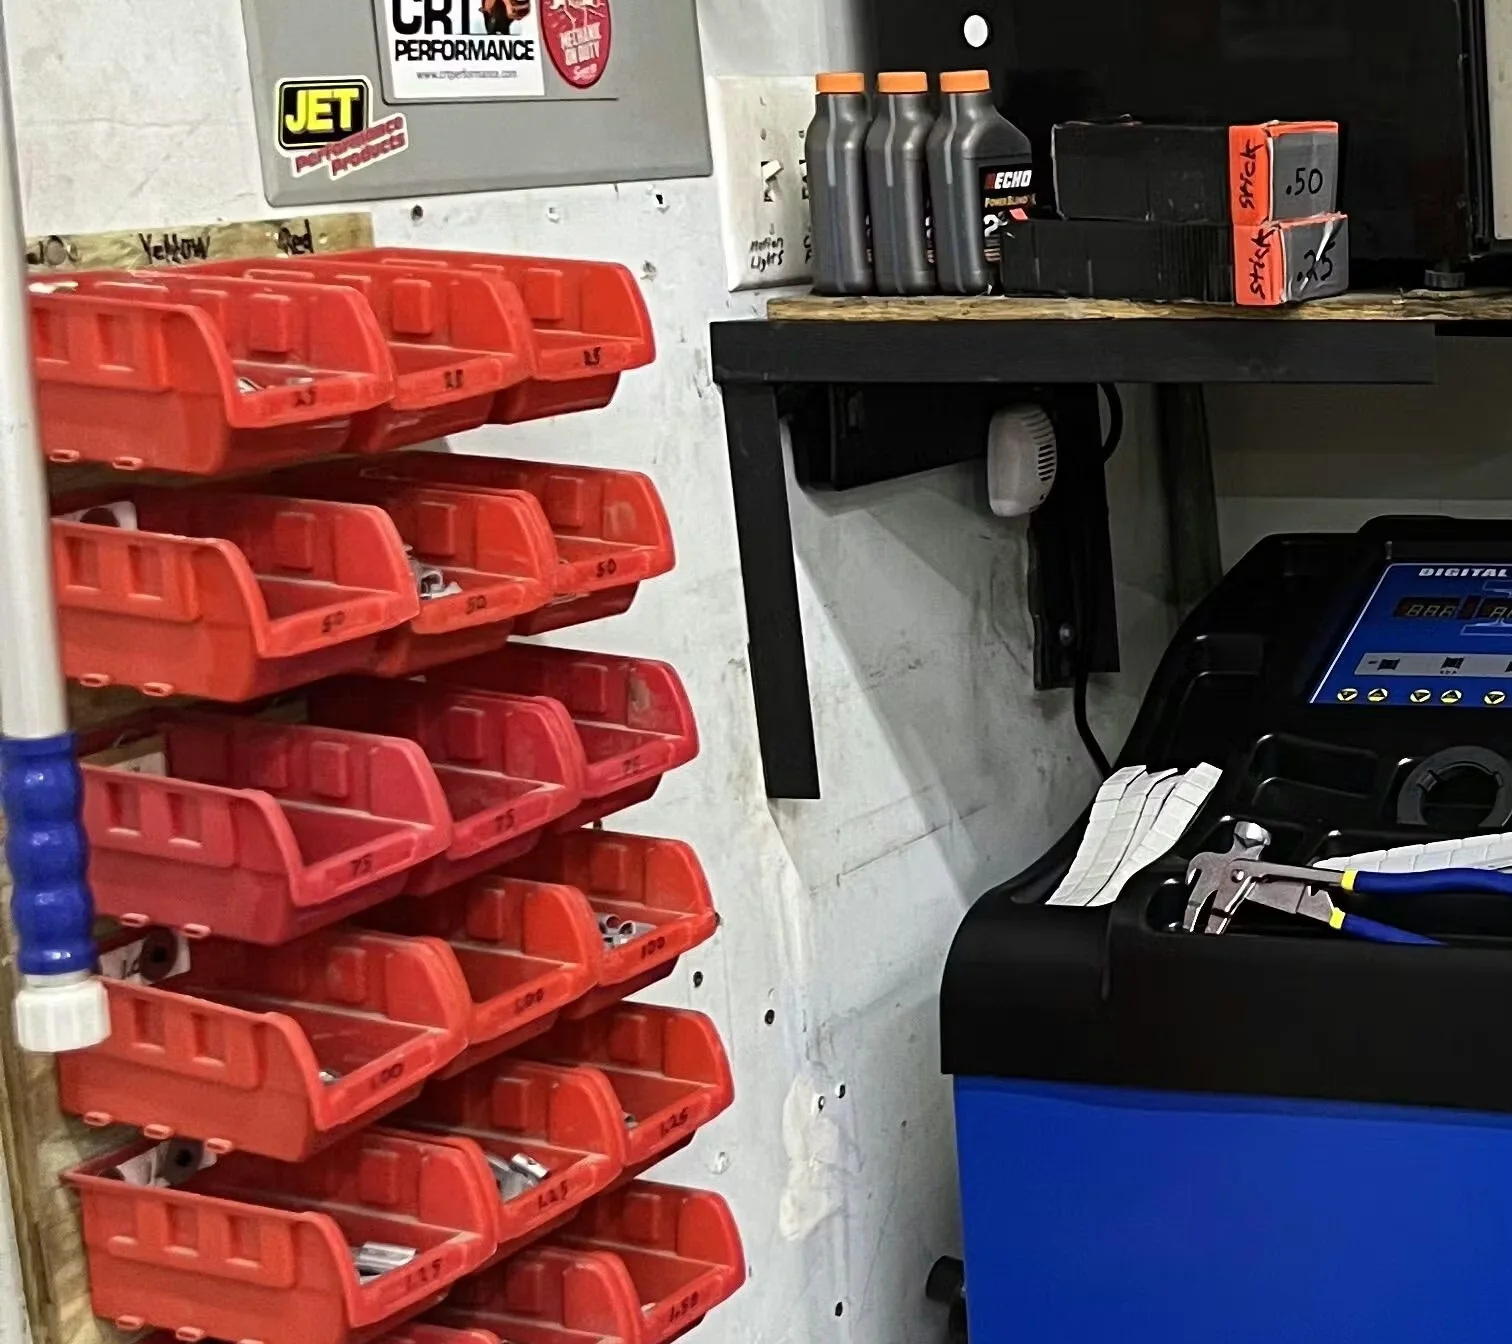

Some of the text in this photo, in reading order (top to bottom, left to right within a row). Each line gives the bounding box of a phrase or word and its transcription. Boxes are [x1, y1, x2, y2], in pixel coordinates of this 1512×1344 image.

[394, 39, 535, 61] PERFORMANCE
[285, 87, 360, 134] JET
[994, 169, 1033, 189] ECHO
[1286, 167, 1323, 196] .50
[1418, 567, 1508, 577] DIGITAL
